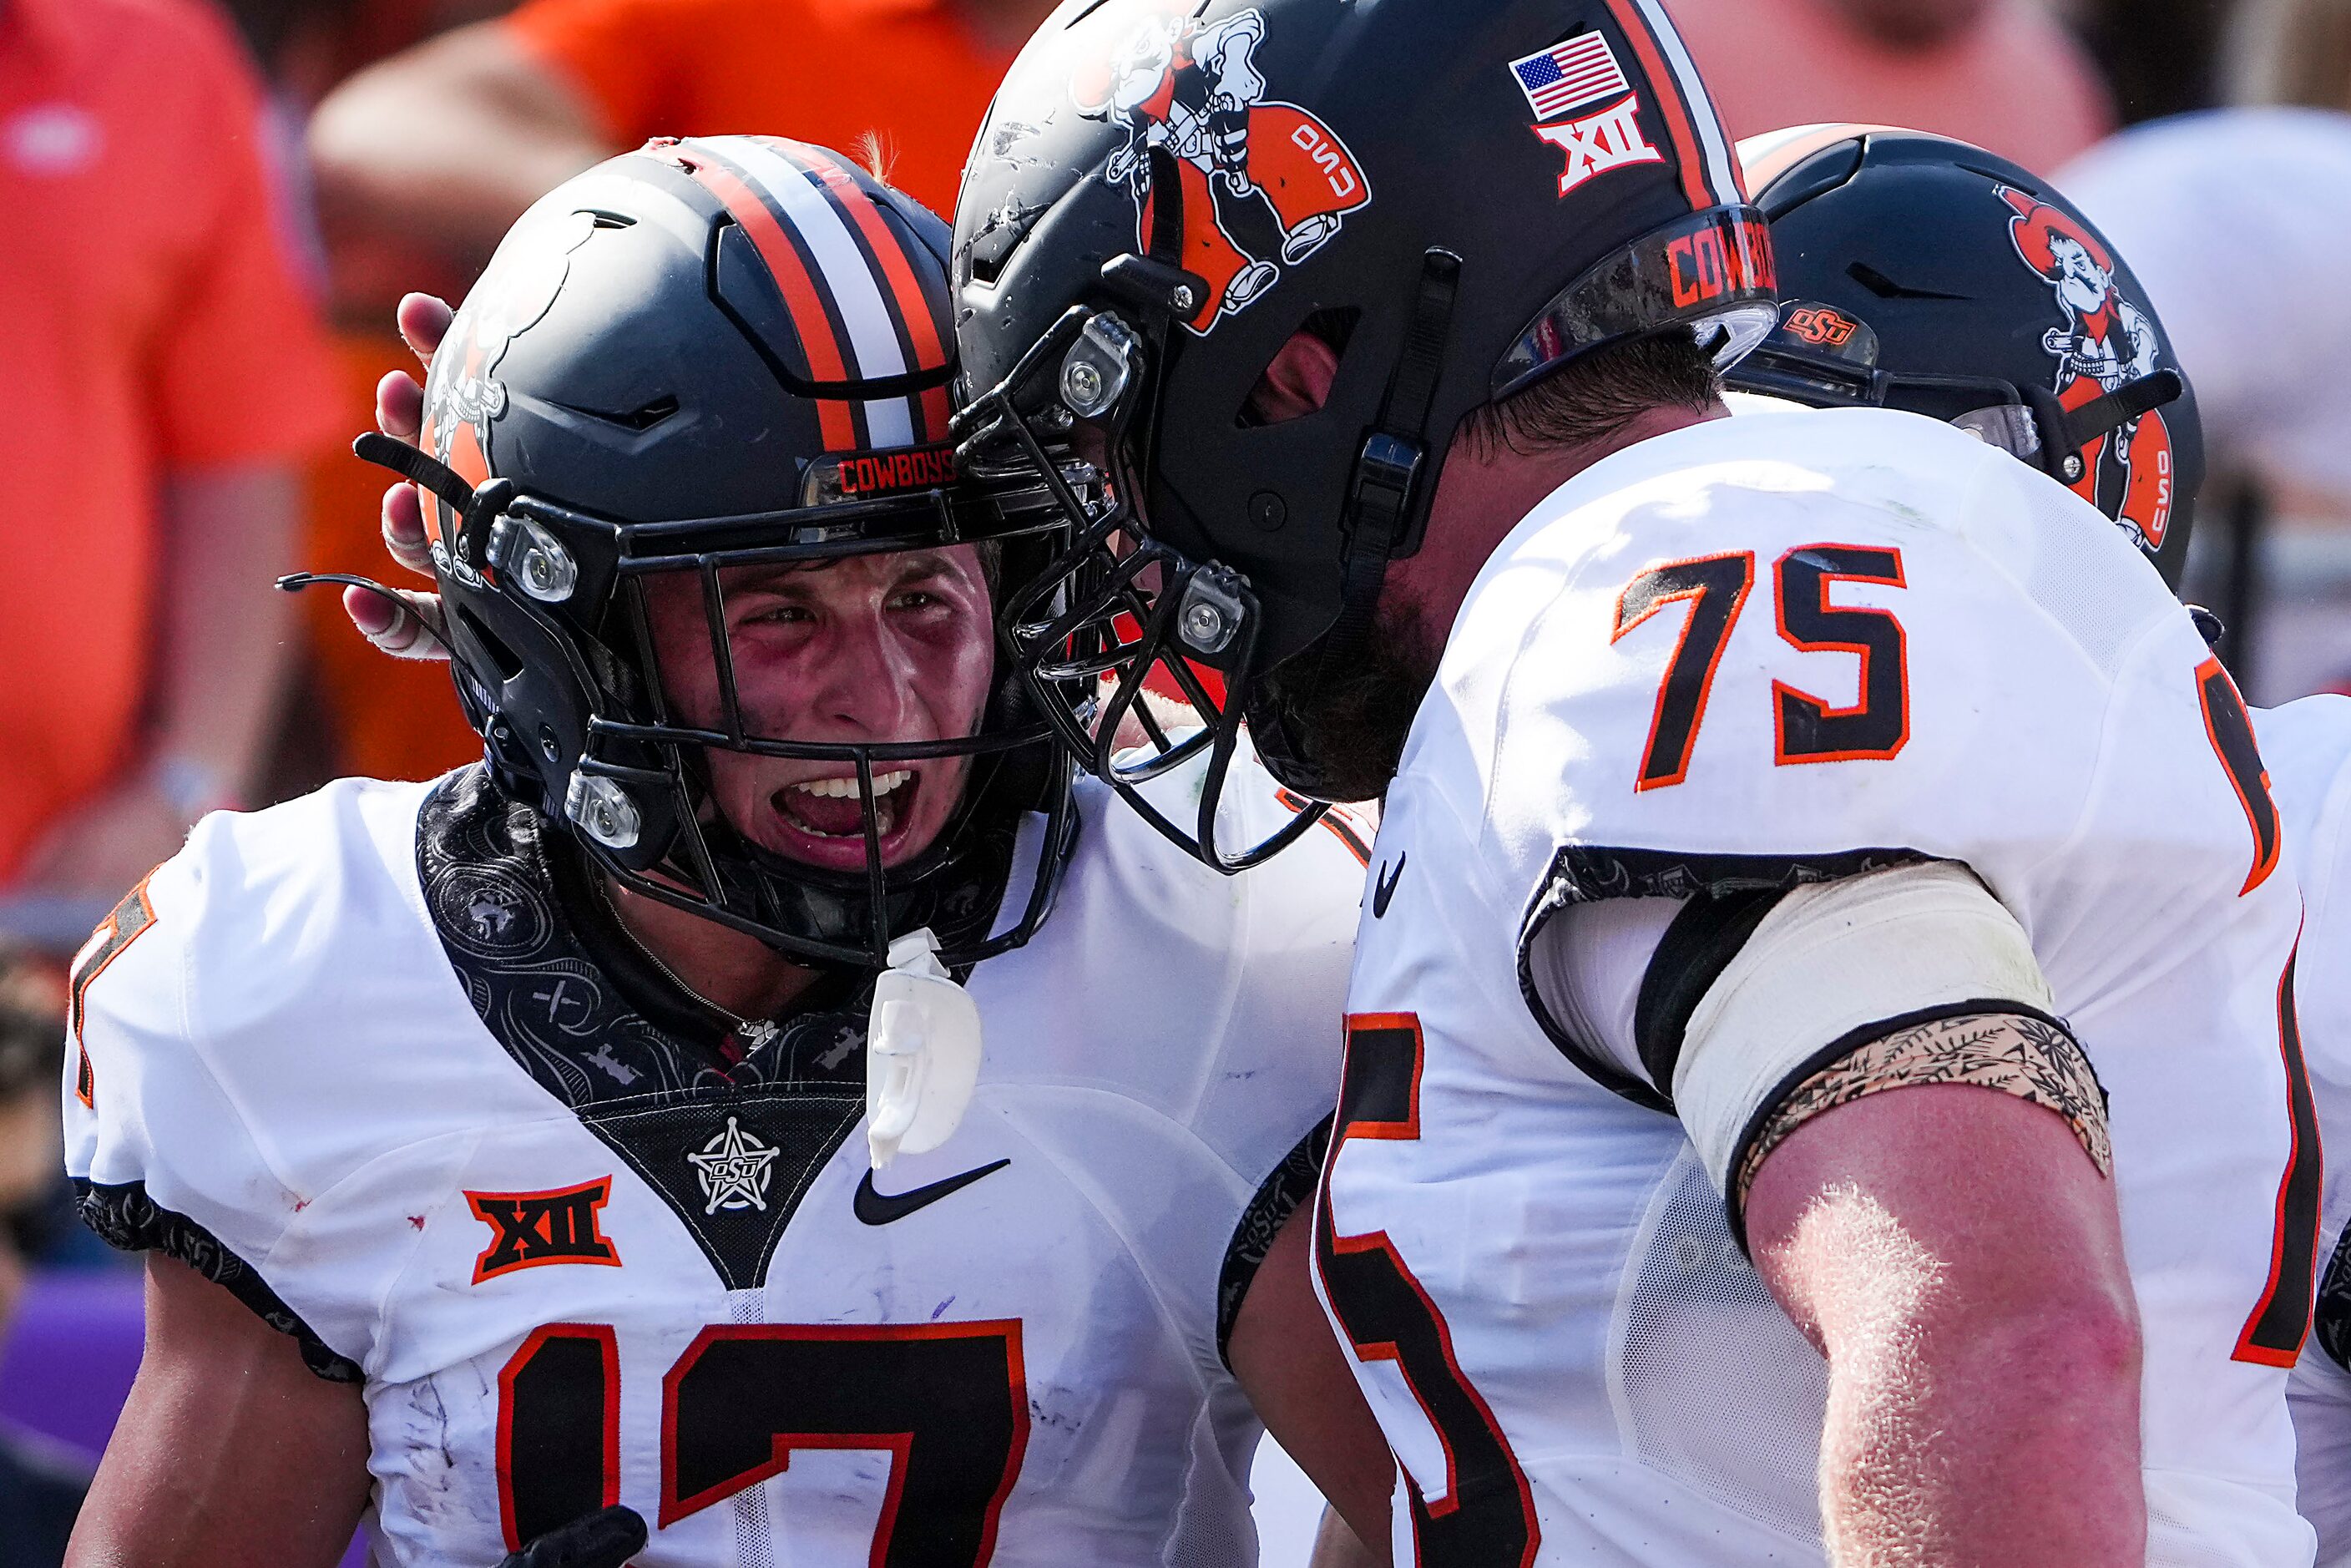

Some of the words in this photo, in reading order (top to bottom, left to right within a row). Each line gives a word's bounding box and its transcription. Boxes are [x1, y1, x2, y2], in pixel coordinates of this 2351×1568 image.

[1291, 124, 1355, 197] OSU
[1530, 90, 1665, 198] XII
[1666, 220, 1778, 307] COWBO
[1782, 309, 1857, 345] OSU
[838, 450, 957, 493] COWBOYS
[2151, 450, 2171, 532] OSU
[1610, 542, 1909, 794] 75
[709, 1156, 761, 1184] OSU
[463, 1174, 621, 1285] XII
[496, 1318, 1030, 1568] 17
